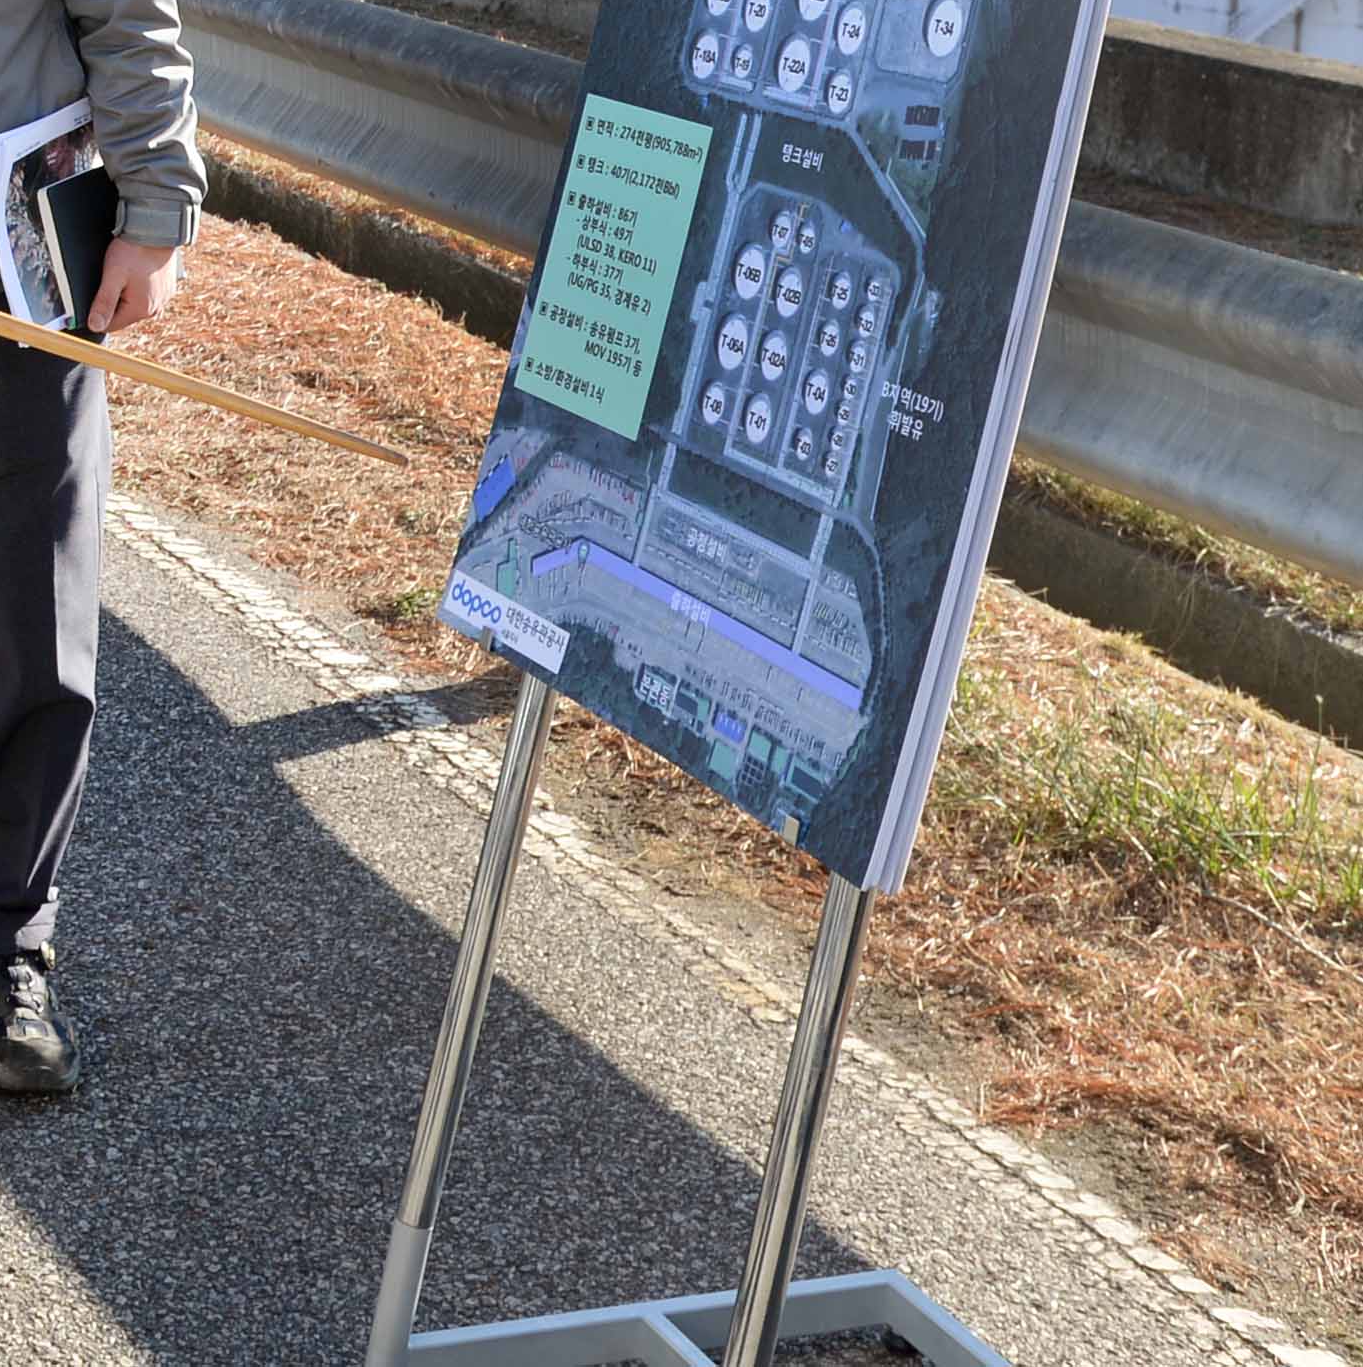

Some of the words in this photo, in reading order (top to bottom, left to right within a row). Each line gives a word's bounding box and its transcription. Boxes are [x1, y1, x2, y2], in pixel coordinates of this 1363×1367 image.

[748, 2, 767, 18] T-20
[842, 22, 861, 40] T-24
[934, 19, 955, 36] T-34
[782, 57, 806, 75] T-22A
[830, 85, 849, 102] T-23
[596, 119, 614, 134] 면적
[587, 157, 604, 174] 탱크
[782, 143, 824, 173] 탱크설비
[578, 194, 611, 219] 출하설비
[617, 208, 638, 227] 86기
[581, 215, 607, 236] 상부식
[613, 224, 634, 245] 49기
[577, 234, 603, 254] (ULSD
[618, 248, 642, 268] KERO
[642, 258, 658, 276] 11)
[572, 253, 598, 275] 하부식
[603, 264, 624, 282] 37기
[737, 263, 762, 283] T-06B
[567, 272, 599, 294] (UG/PG
[777, 284, 802, 305] T-02B
[550, 305, 584, 332] 공정설비
[589, 322, 624, 346] 송유펌프
[721, 333, 745, 356] T-06A
[584, 340, 607, 359] MOV
[608, 351, 632, 373] 195기
[632, 360, 643, 378] 등
[762, 348, 787, 371] T-02A
[535, 362, 591, 398] 소방/환경설비
[590, 386, 606, 404] 1식
[806, 382, 827, 403] T-04
[881, 381, 945, 423] B지역(19기)
[748, 410, 767, 431] T-01
[889, 410, 924, 441] 휘발유
[452, 579, 502, 624] dopco
